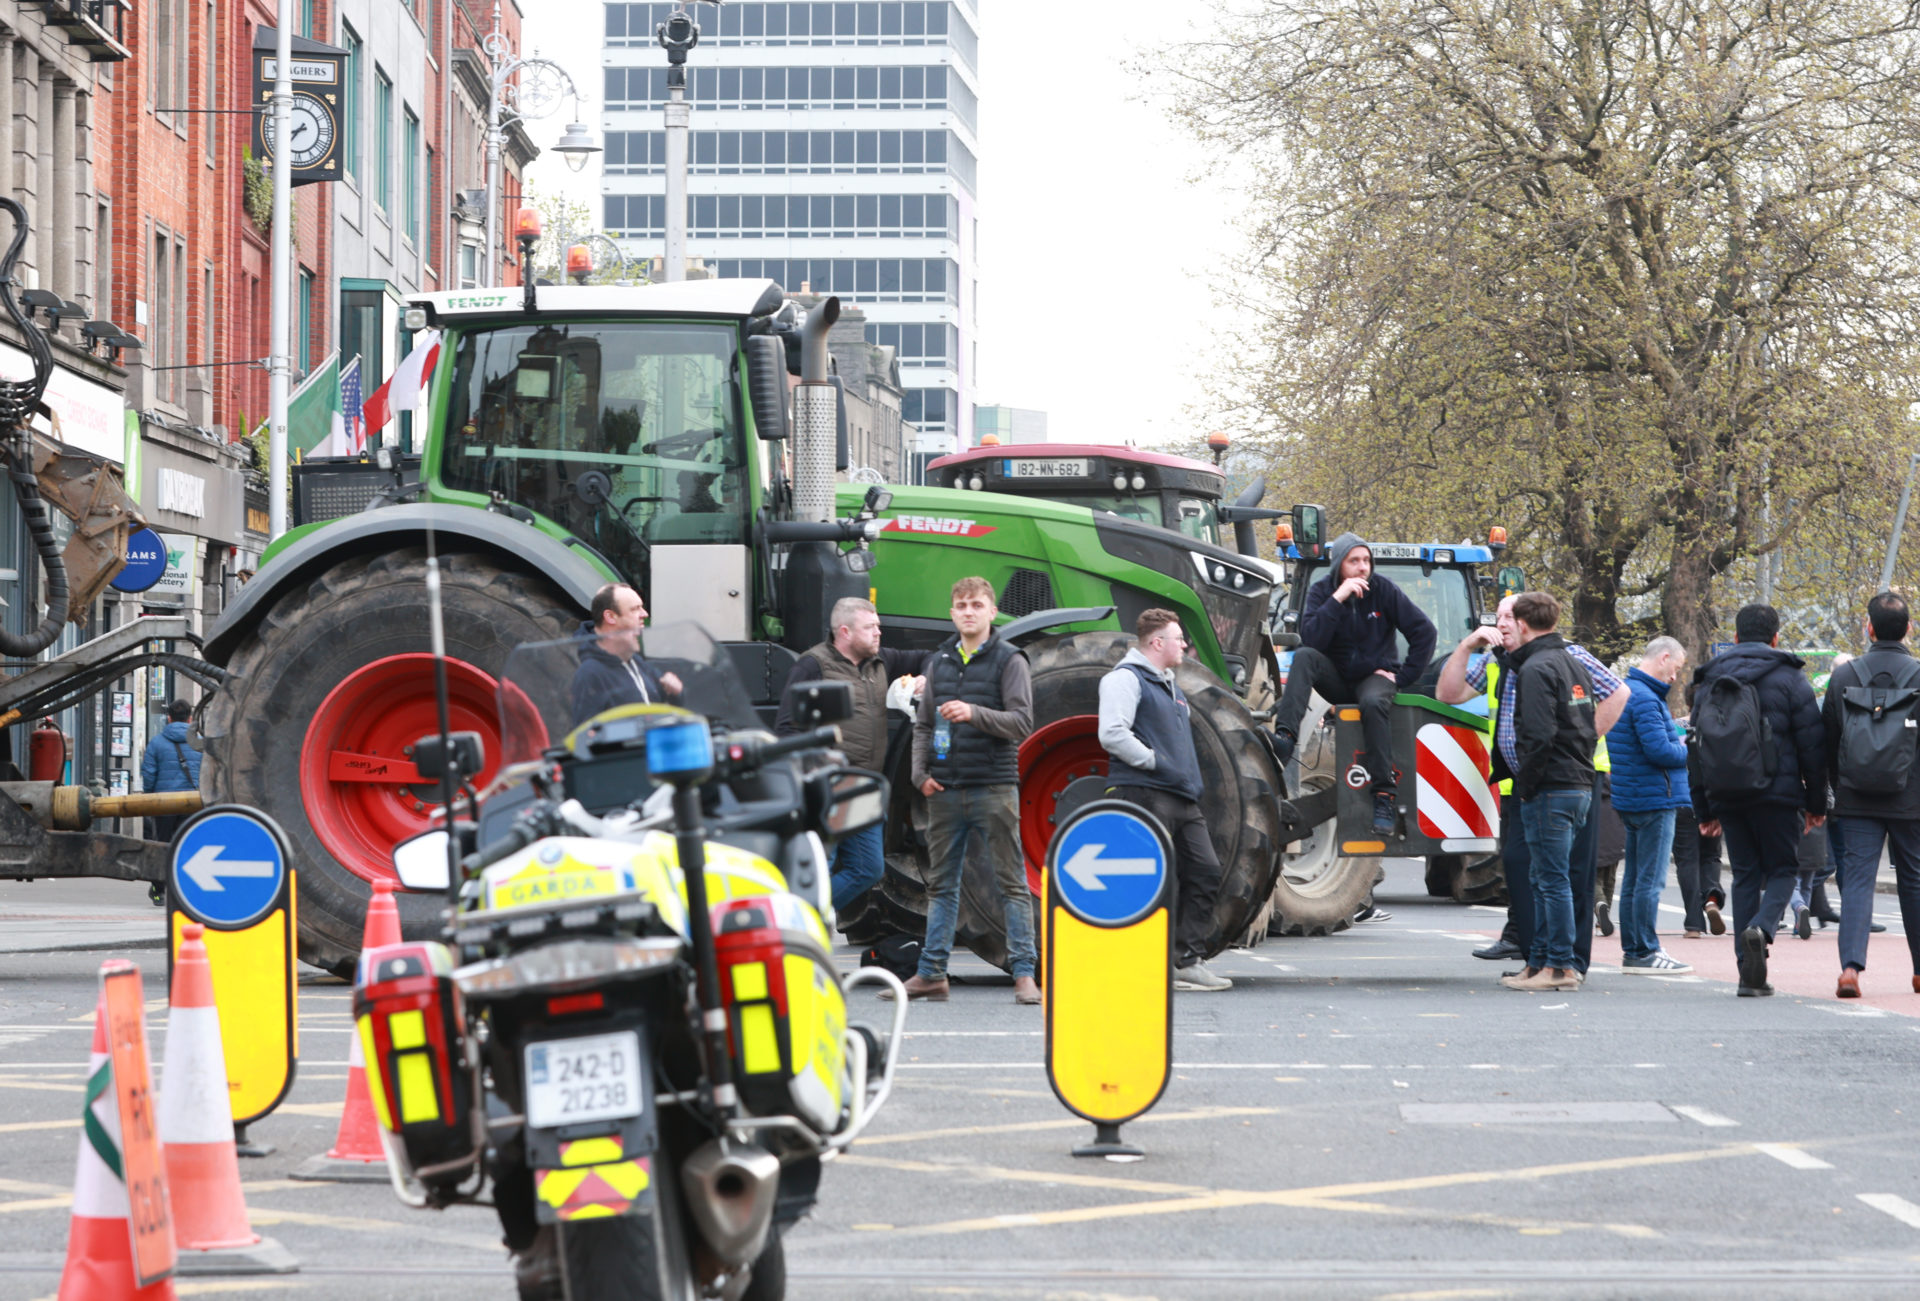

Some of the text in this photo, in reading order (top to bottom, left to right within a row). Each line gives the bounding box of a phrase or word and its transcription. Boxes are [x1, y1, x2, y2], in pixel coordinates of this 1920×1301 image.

[447, 296, 508, 309] FENDT
[1017, 463, 1081, 476] 182-MN-682
[897, 514, 977, 535] FENDT
[511, 876, 596, 901] GARDA
[557, 1050, 624, 1082] 242-D
[560, 1082, 627, 1113] 21238
